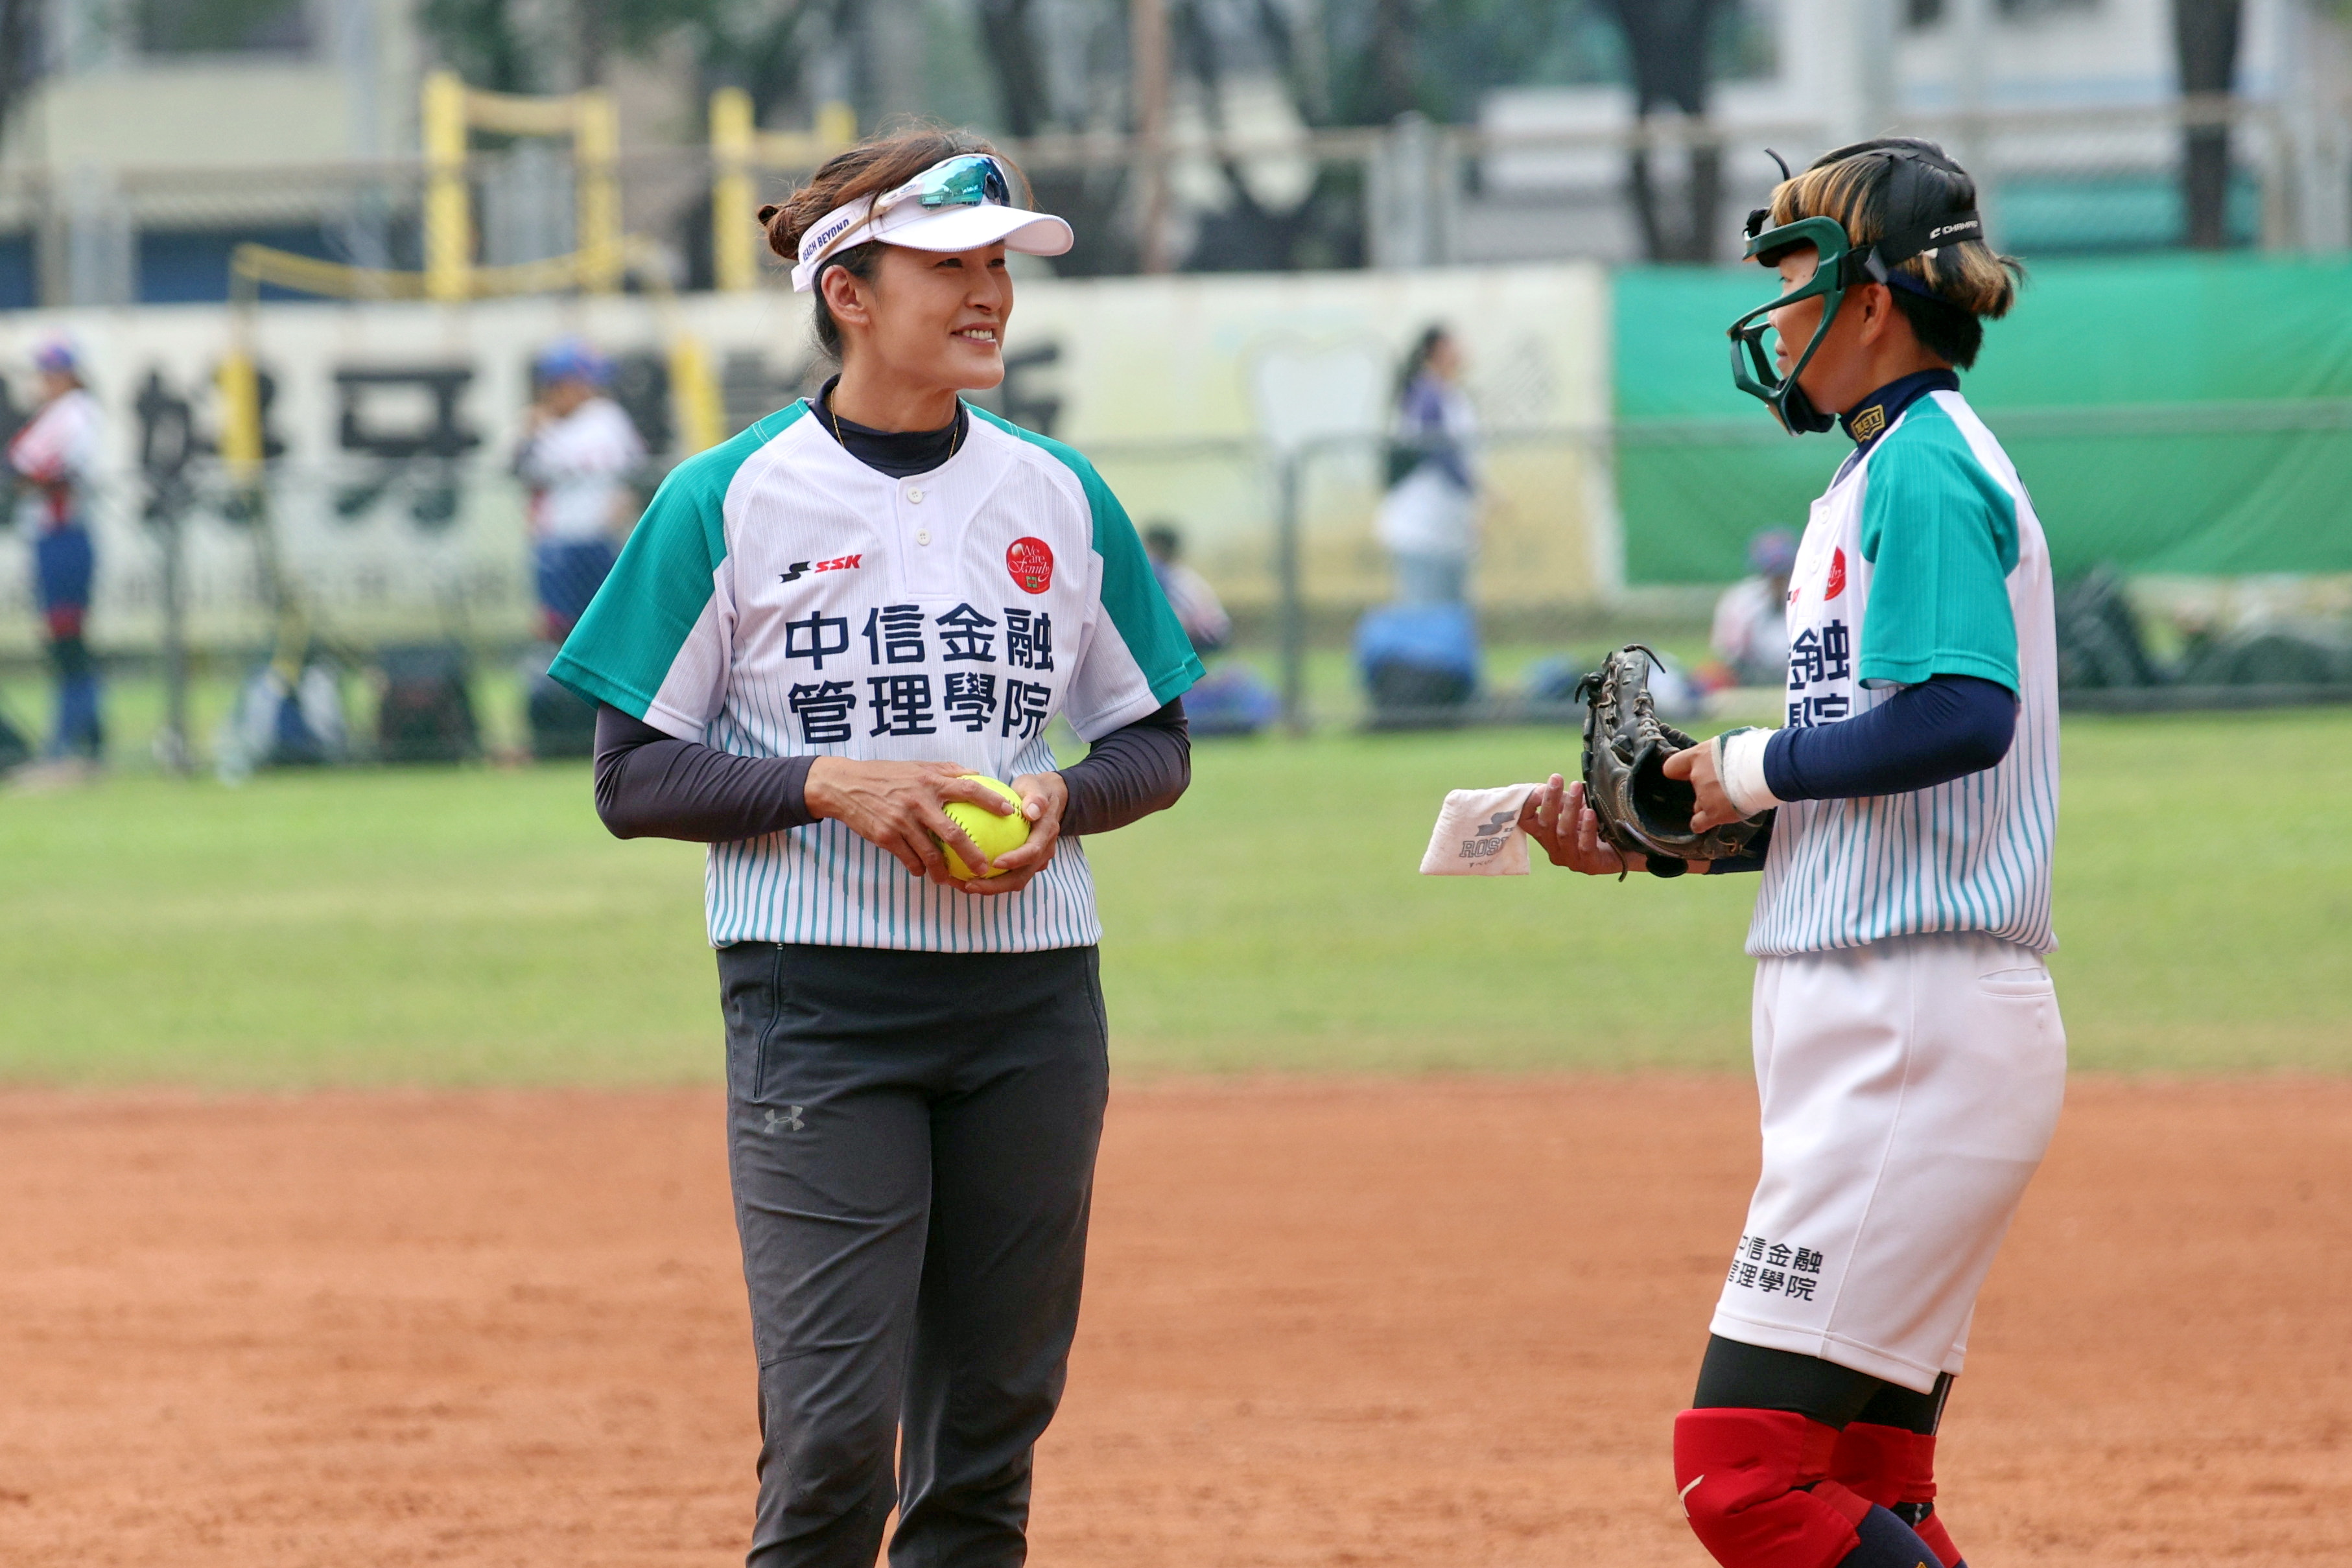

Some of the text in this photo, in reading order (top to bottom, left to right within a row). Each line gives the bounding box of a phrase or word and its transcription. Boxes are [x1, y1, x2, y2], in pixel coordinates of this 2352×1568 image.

[817, 218, 850, 248] BEYOND
[1855, 410, 1881, 435] ZETT
[1021, 544, 1040, 556] We
[1028, 555, 1046, 565] are
[814, 554, 862, 574] SSK
[1007, 555, 1050, 583] Family
[785, 602, 1055, 673] 中信金融
[788, 671, 1052, 744] 管理學院
